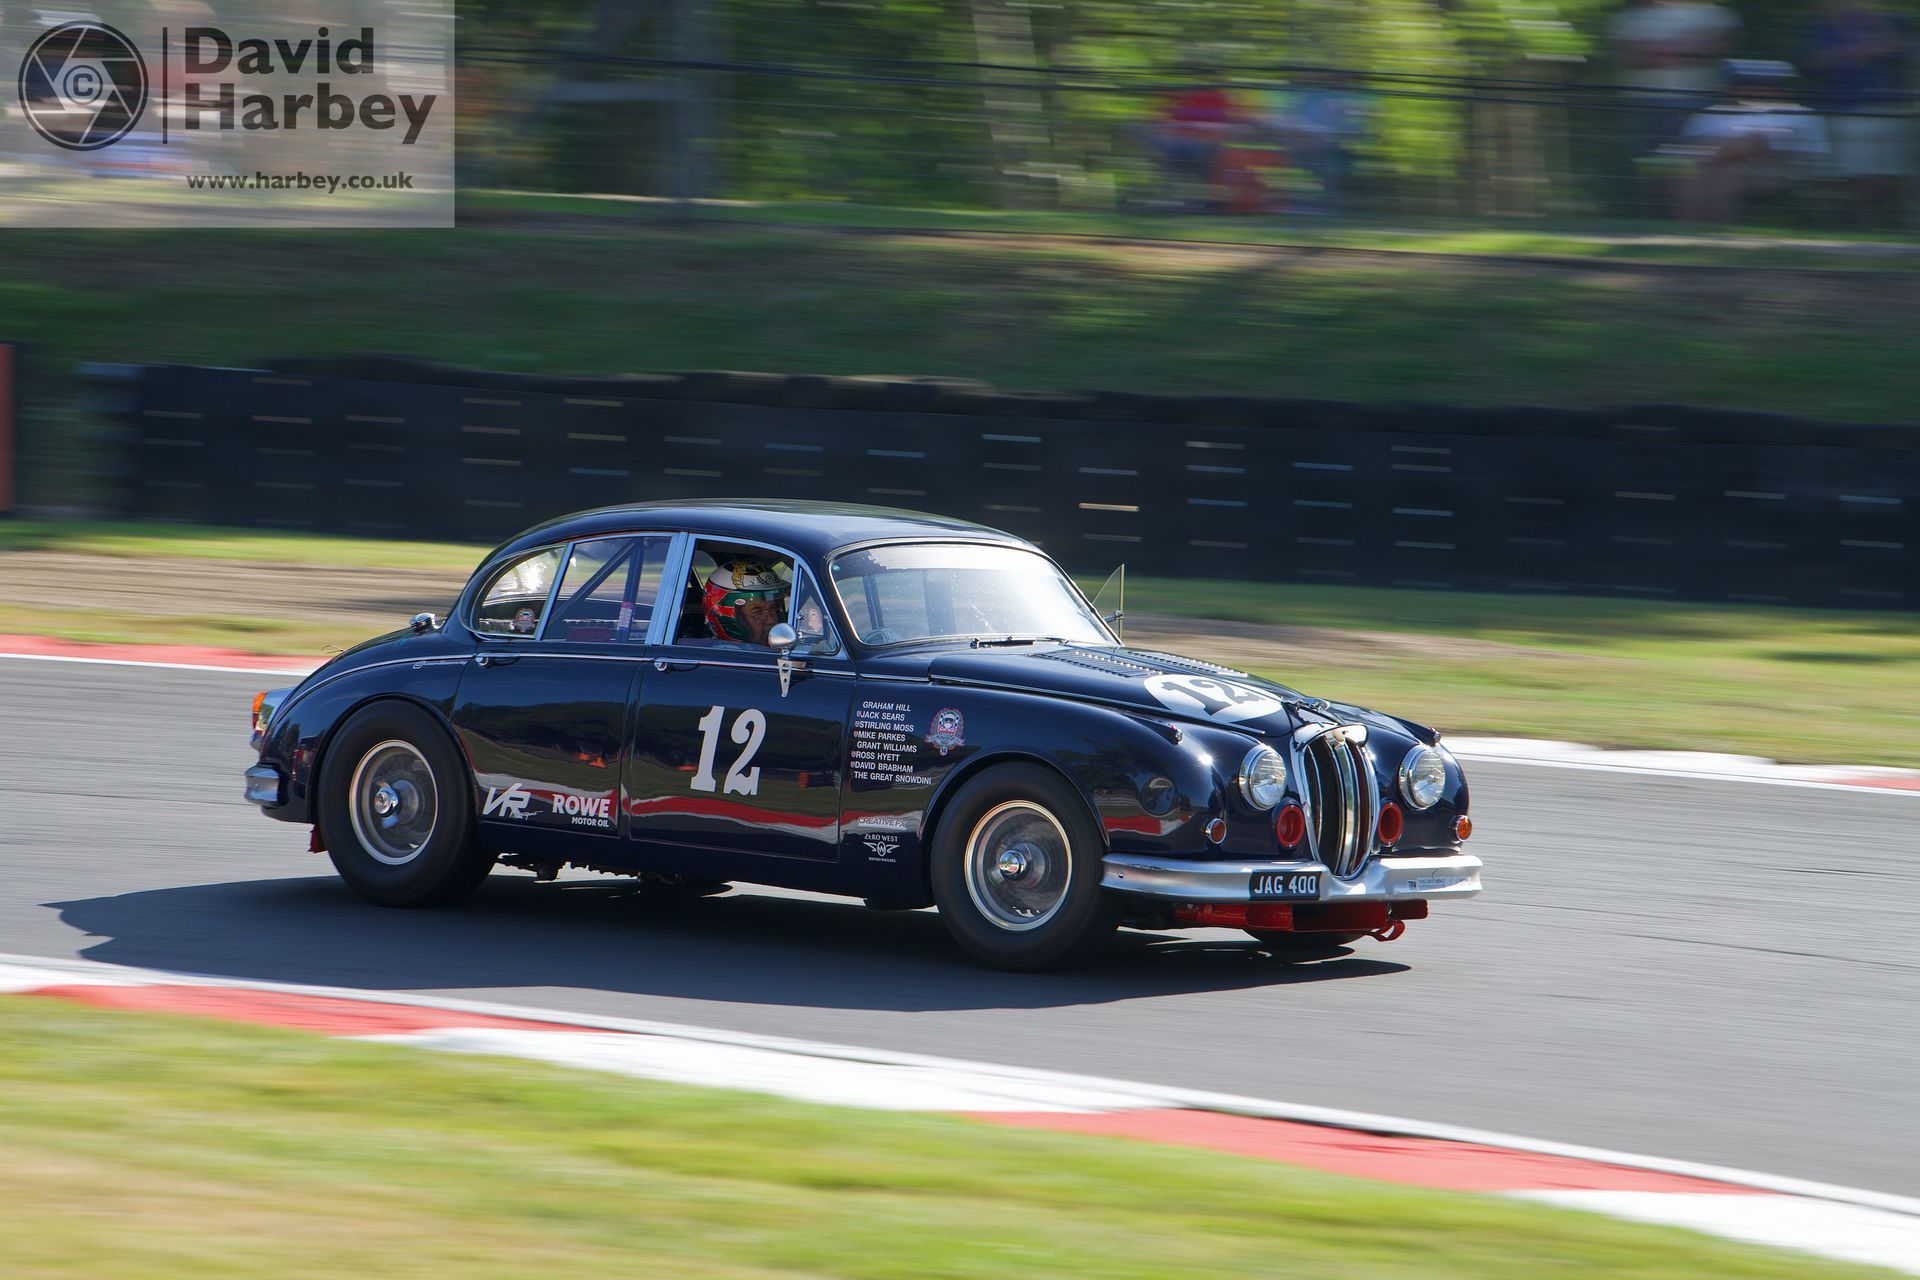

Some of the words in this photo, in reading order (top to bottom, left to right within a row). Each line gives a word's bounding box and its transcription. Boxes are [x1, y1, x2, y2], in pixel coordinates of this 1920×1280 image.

[1161, 679, 1265, 716] 12
[862, 701, 894, 711] GRAHAM
[895, 702, 912, 712] HILL
[860, 711, 880, 720] JACK
[881, 712, 905, 722] SEARS
[859, 721, 891, 731] STIRLING
[893, 723, 915, 733] MOSS
[857, 731, 876, 740] MIKE
[877, 732, 906, 742] PARKES
[690, 705, 767, 795] 12
[856, 741, 882, 751] GRANT
[883, 743, 918, 753] WILLIAMS
[855, 751, 876, 760] ROSS
[877, 752, 901, 762] HYETT
[854, 761, 877, 770] DAVID
[877, 763, 914, 774] BRABHAM
[854, 771, 868, 780] THE
[870, 772, 894, 782] GREAT
[895, 774, 932, 785] SNOWDINI
[482, 783, 531, 818] VR
[552, 794, 611, 818] ROWE
[571, 816, 597, 826] MOTOR
[597, 818, 610, 828] OIL
[1254, 876, 1284, 894] JAG
[1288, 876, 1317, 894] 400
